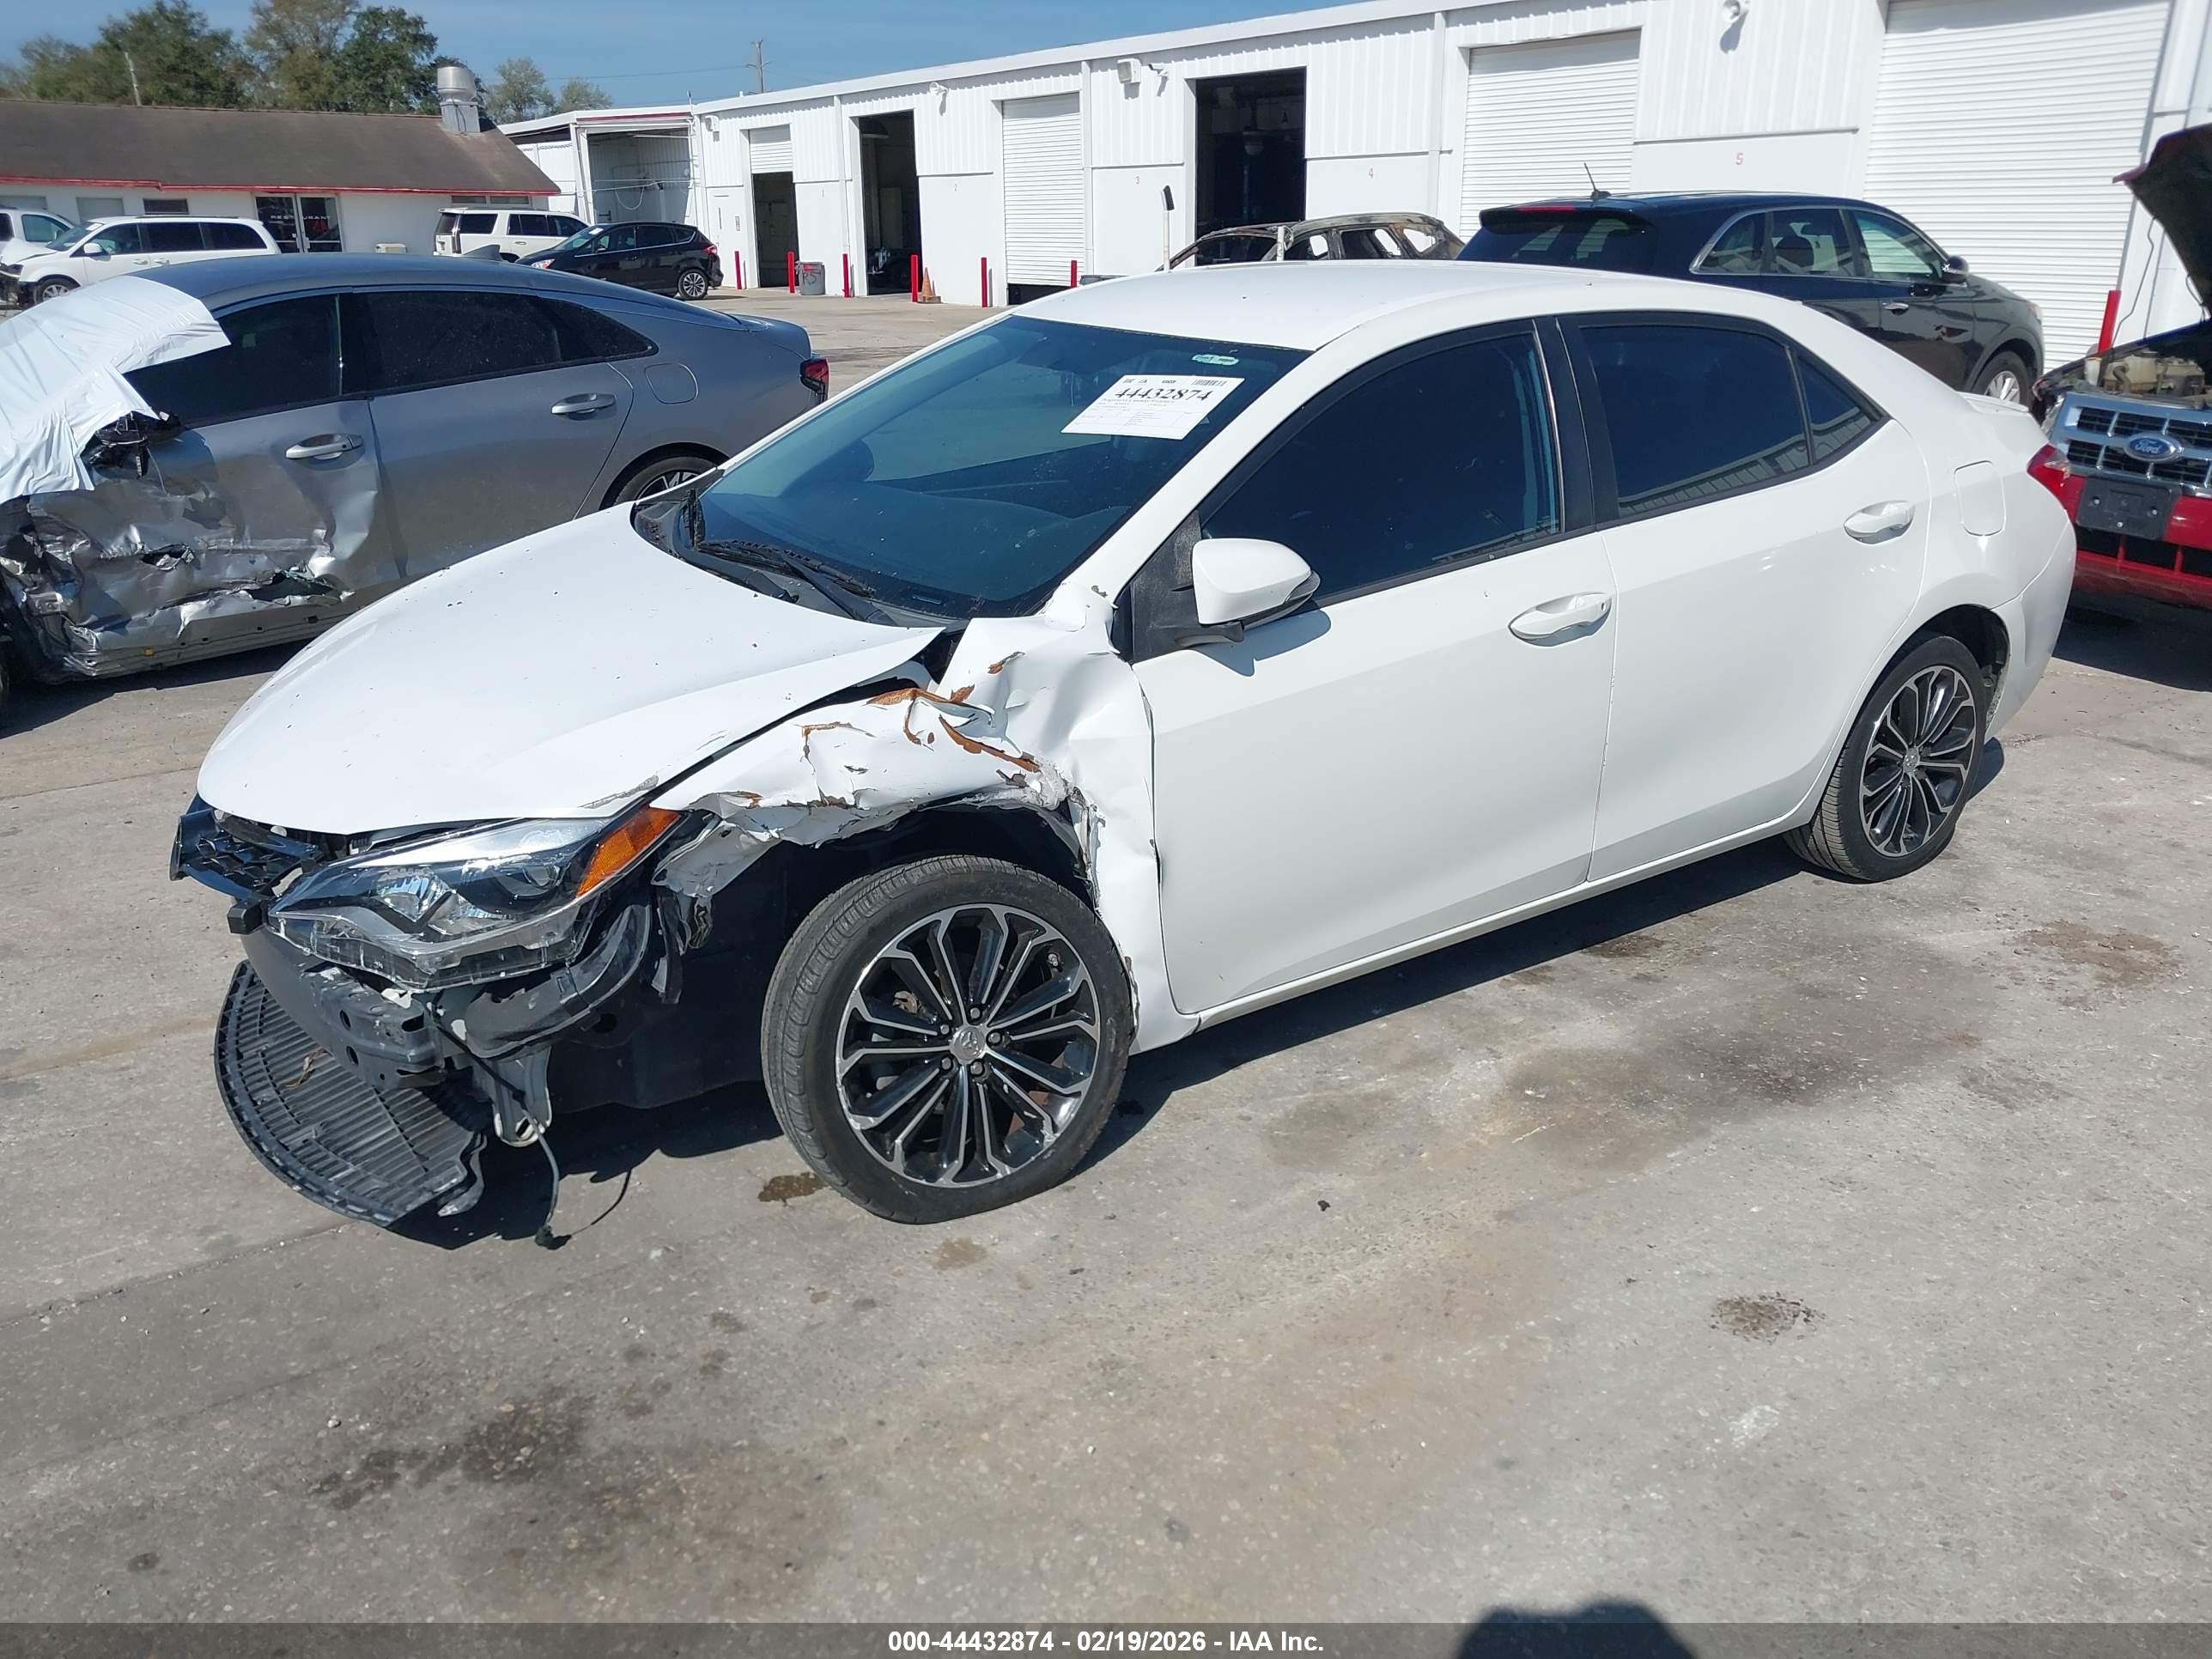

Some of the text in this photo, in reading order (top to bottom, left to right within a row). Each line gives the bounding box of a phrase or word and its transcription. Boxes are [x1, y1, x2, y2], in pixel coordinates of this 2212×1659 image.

[1735, 151, 1744, 166] 5
[1134, 175, 1140, 185] 3
[1368, 167, 1374, 179] 4
[1115, 387, 1213, 401] 44432874
[2135, 439, 2163, 454] Ford
